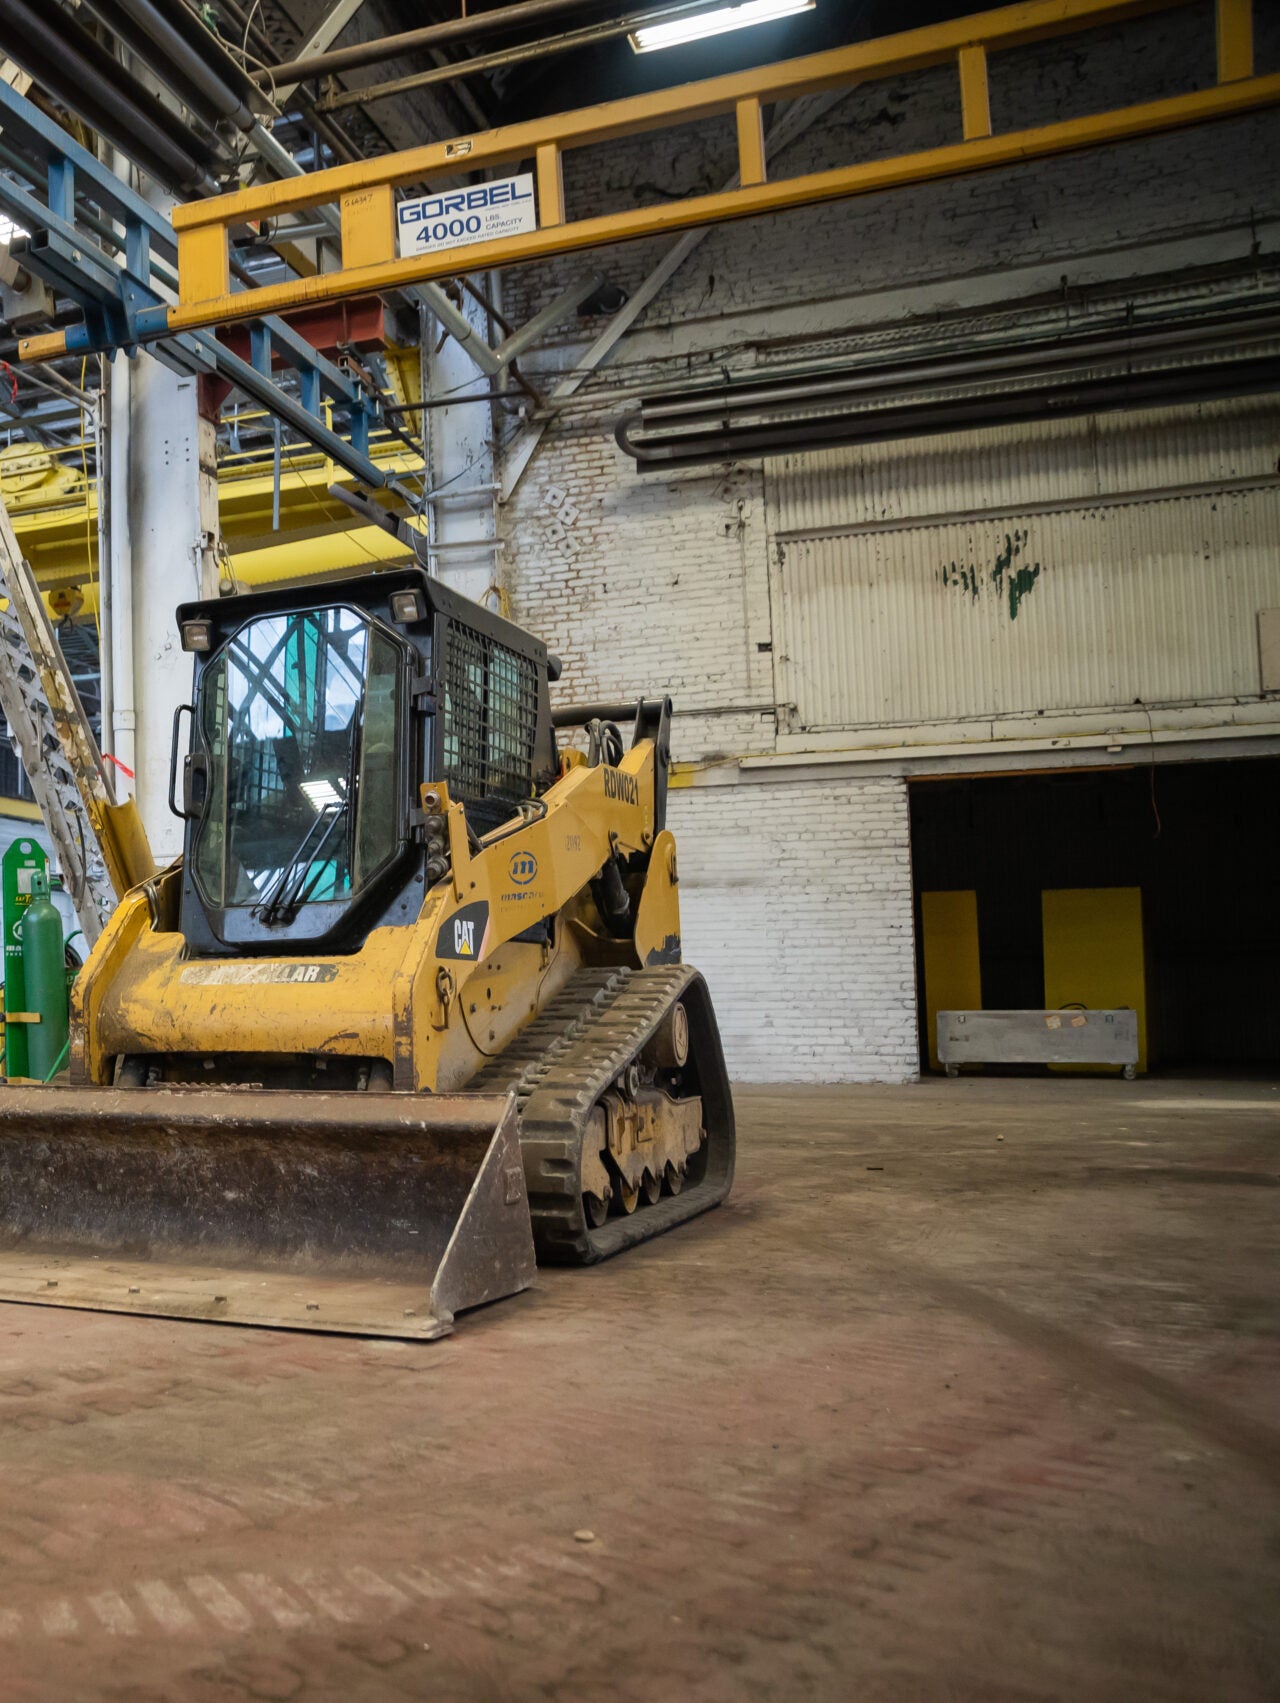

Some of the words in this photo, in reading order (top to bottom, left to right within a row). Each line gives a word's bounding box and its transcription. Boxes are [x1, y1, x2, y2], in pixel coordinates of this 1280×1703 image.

[399, 182, 532, 224] GORBEL
[416, 215, 481, 243] 4000
[485, 217, 523, 230] CAPACITY
[603, 767, 639, 807] RDW021
[454, 919, 475, 955] CAT
